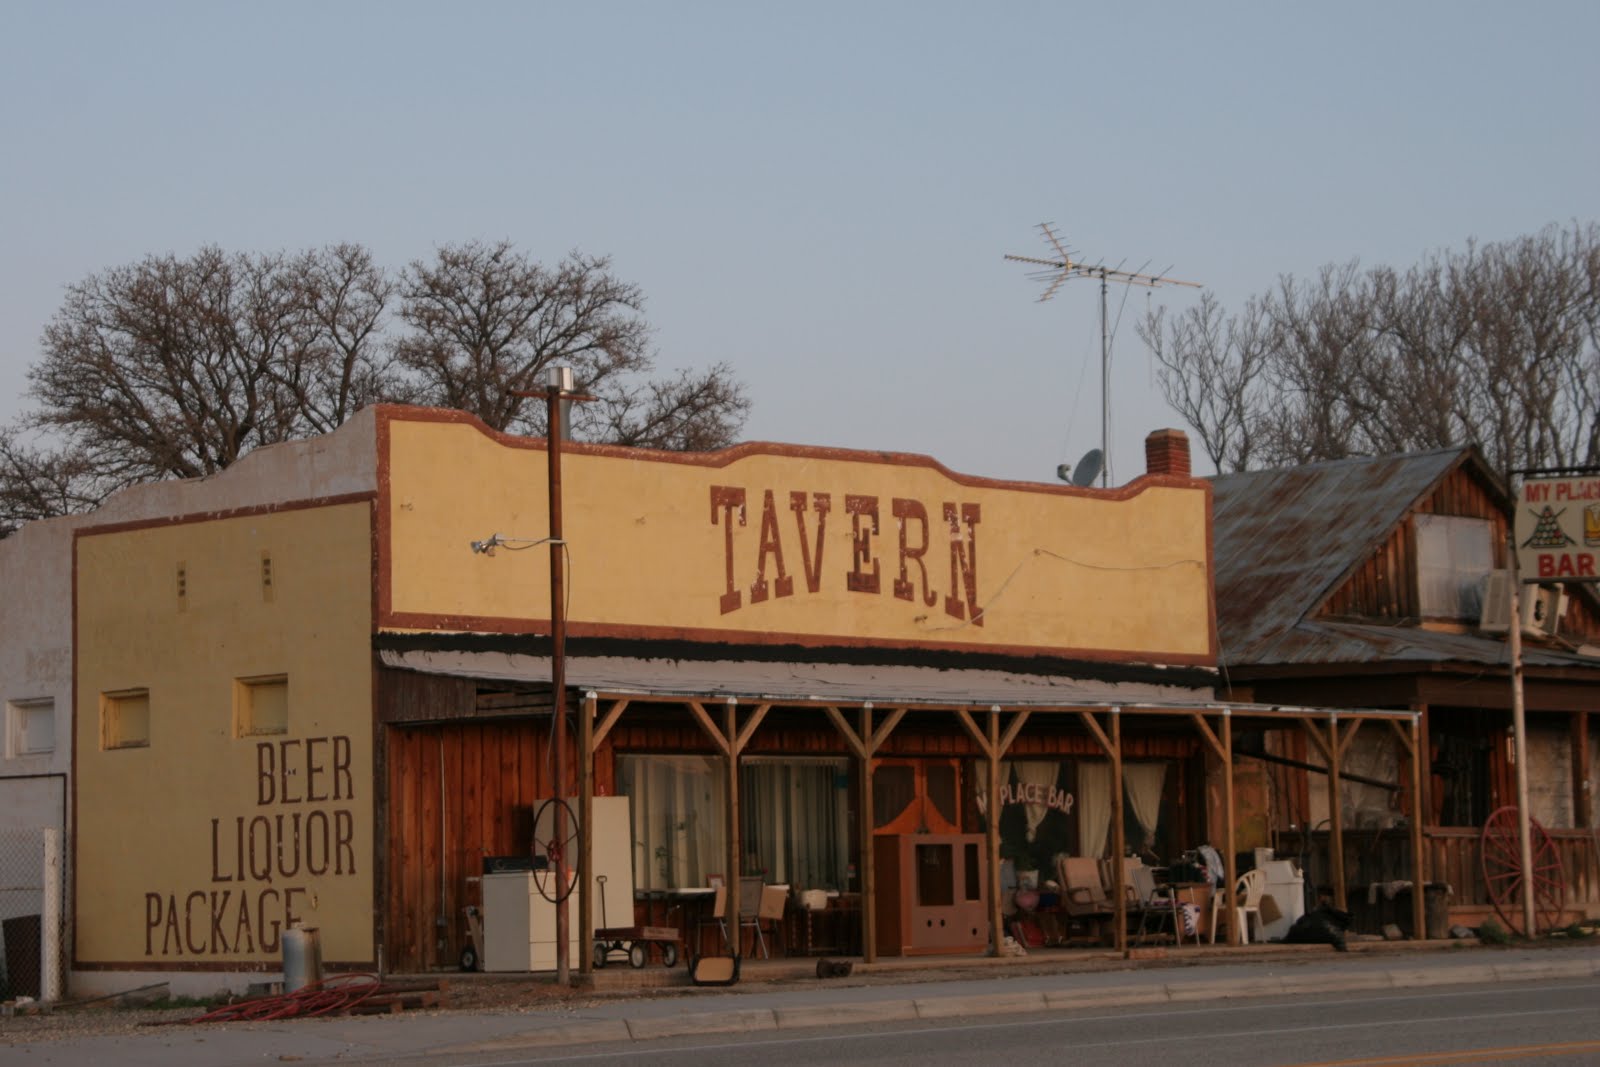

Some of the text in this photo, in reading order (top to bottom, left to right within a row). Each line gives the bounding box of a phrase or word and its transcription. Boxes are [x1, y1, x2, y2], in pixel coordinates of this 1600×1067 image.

[1525, 481, 1600, 502] MY PLAC
[710, 485, 984, 627] TAVERN
[1538, 553, 1595, 577] BAR
[256, 735, 354, 806] BEER
[1000, 783, 1042, 806] PLACE
[1047, 785, 1074, 815] BAR
[211, 809, 356, 883] LIQUOR
